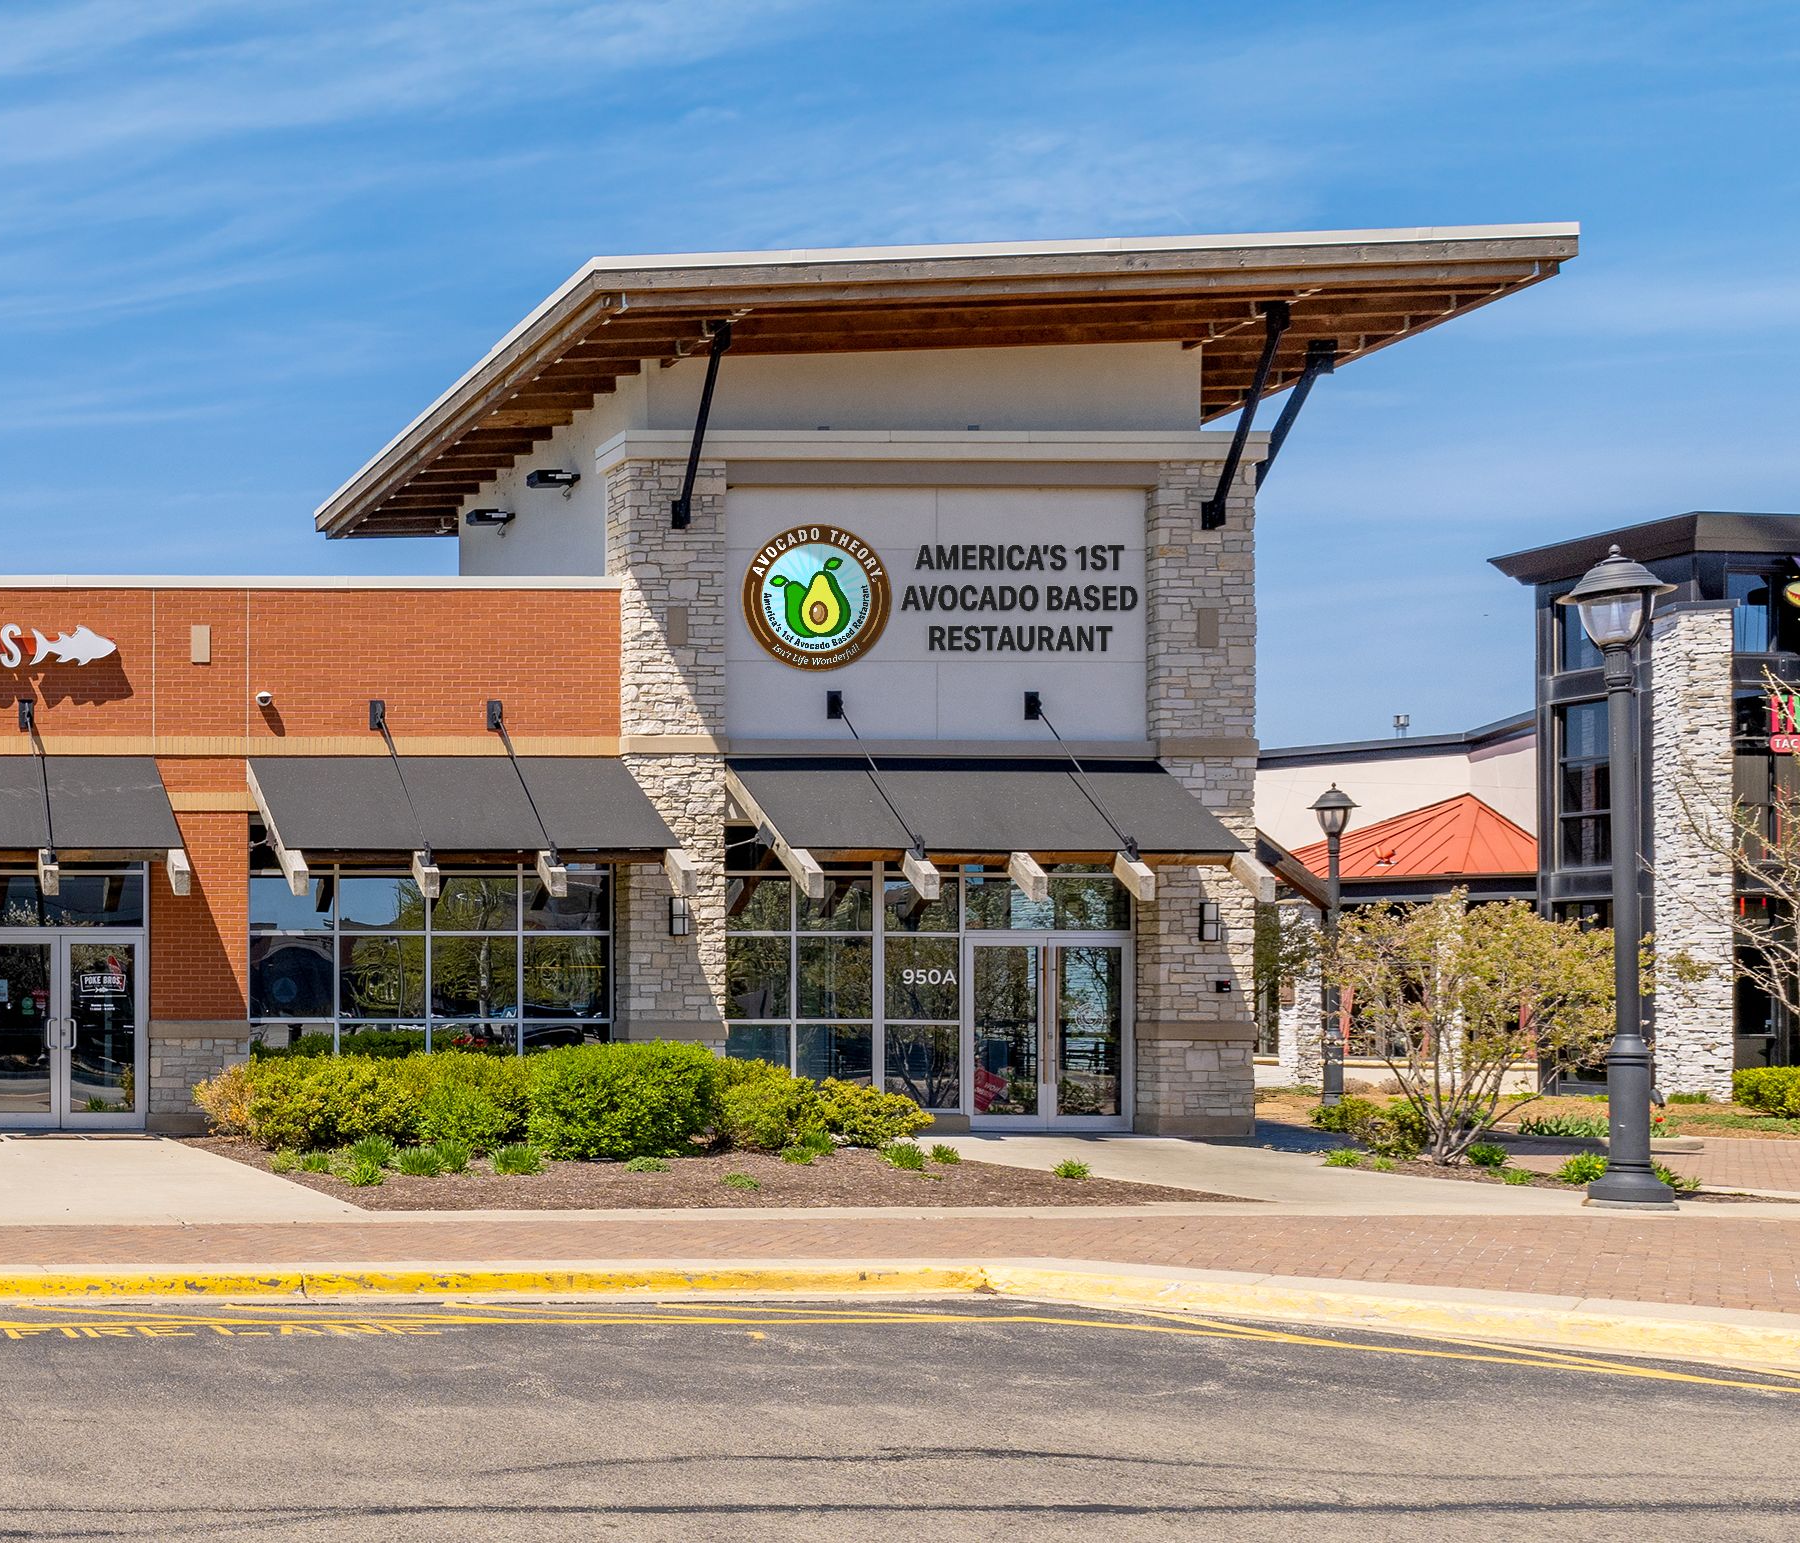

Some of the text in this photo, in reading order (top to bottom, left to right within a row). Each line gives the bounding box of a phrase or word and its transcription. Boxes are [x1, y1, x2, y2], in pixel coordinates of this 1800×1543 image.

[752, 528, 883, 578] AVOCADO THEORY
[915, 544, 1125, 571] AMERICA'S 1ST
[901, 585, 1138, 612] AVOCADO BASED
[763, 584, 870, 650] America's 1st Avocado Based Restaurant
[928, 625, 1113, 652] RESTAURANT
[792, 654, 809, 666] Life
[84, 976, 101, 985] POKE
[902, 969, 957, 985] 950A
[4, 1325, 196, 1340] FIRE
[209, 1323, 441, 1337] LANE
